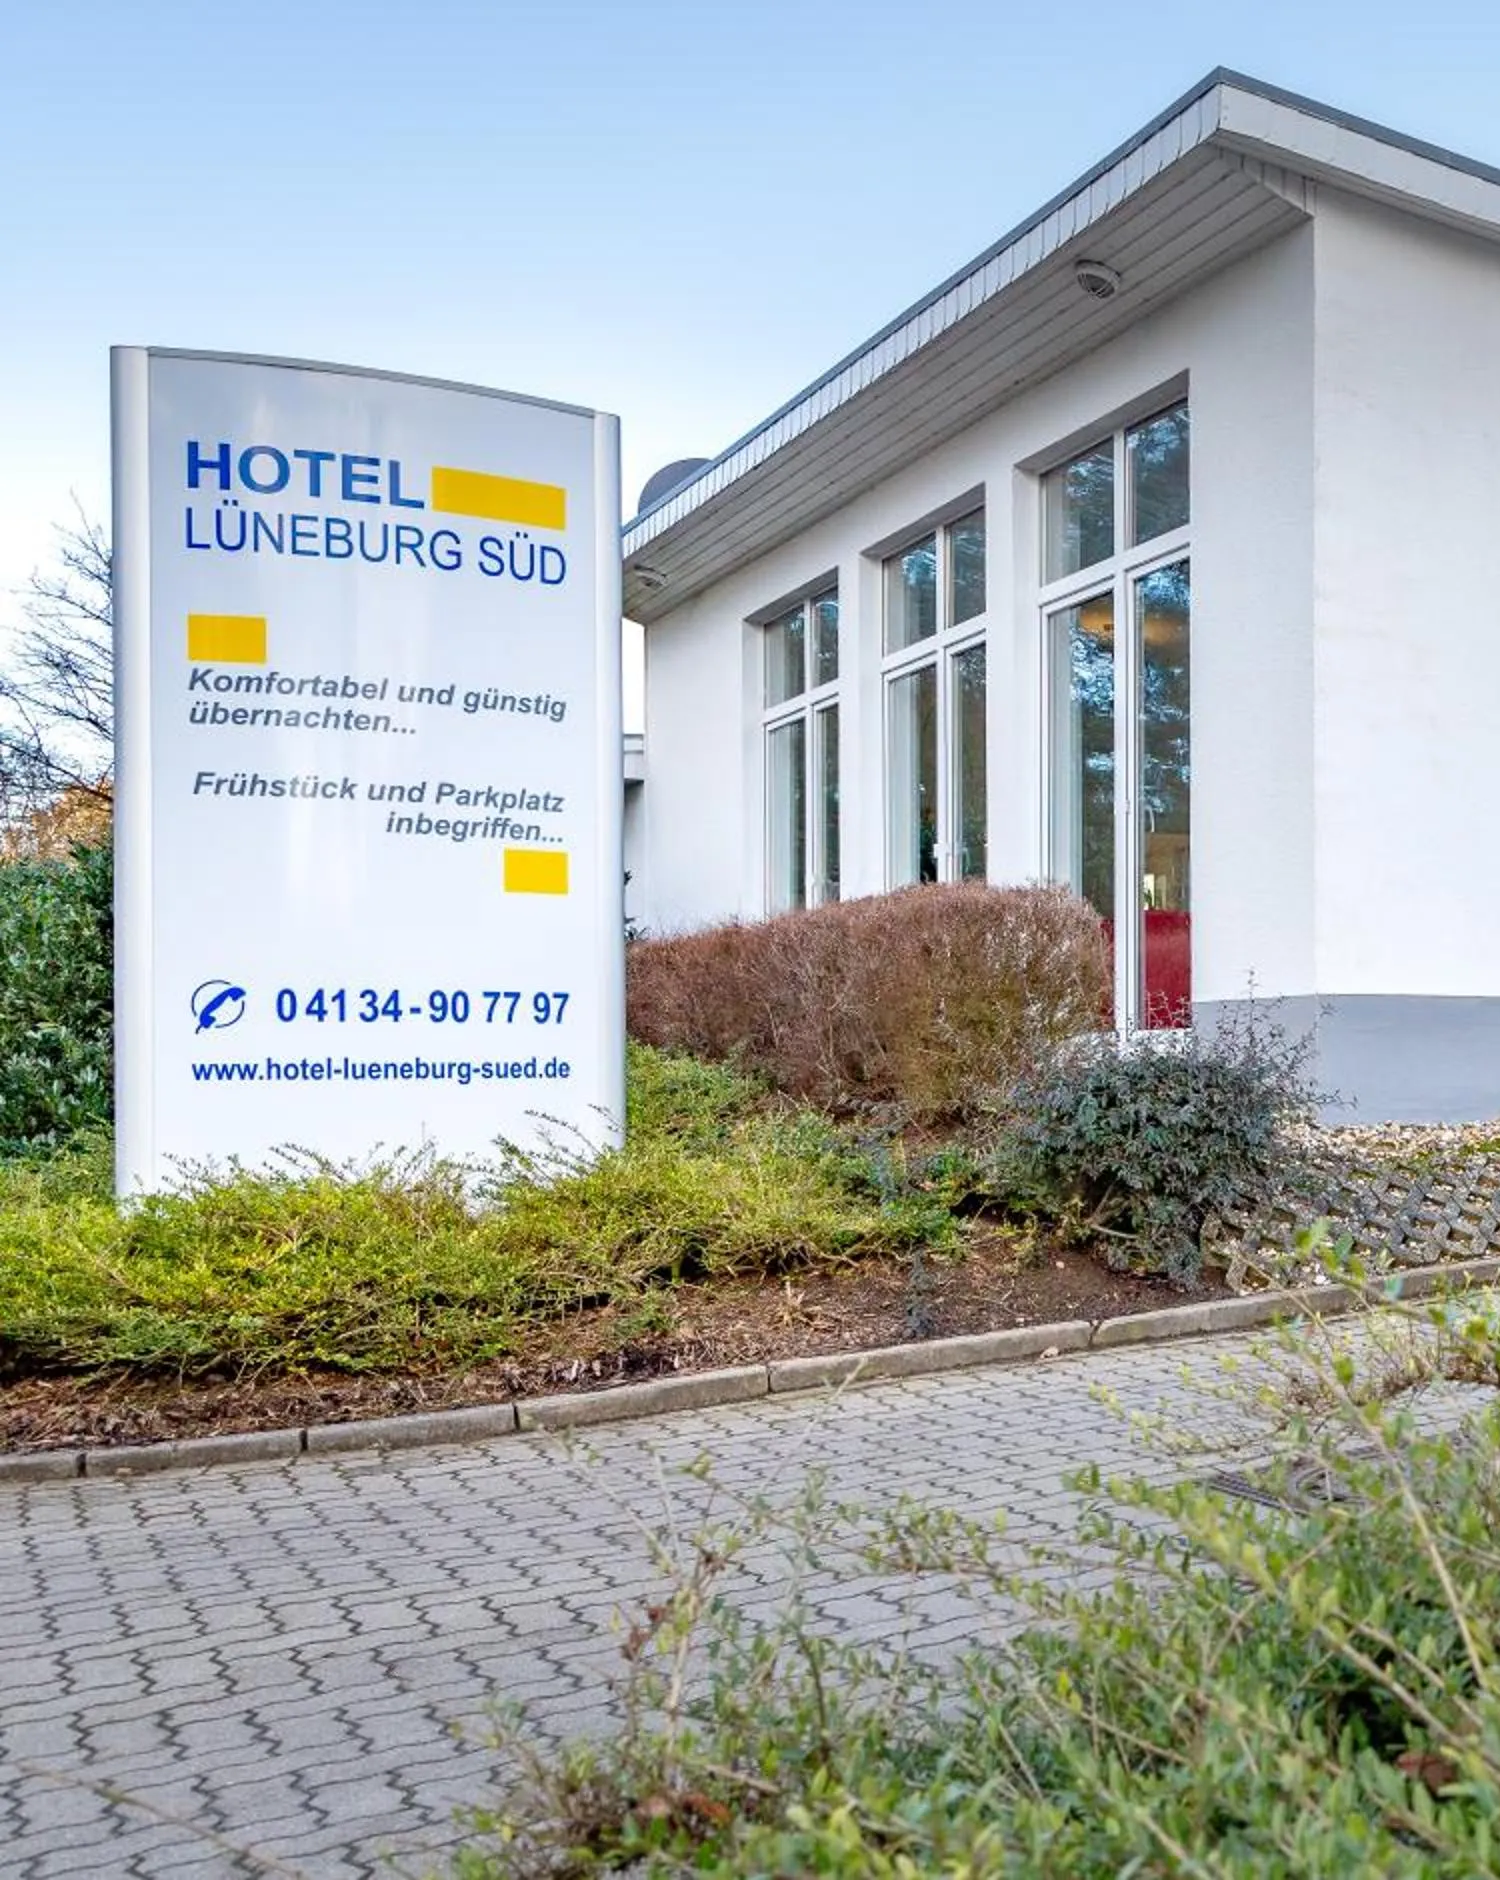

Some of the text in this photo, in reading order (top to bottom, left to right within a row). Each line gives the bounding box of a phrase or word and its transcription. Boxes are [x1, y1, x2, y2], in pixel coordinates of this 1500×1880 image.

[186, 441, 425, 510] HOTEL
[184, 499, 567, 586] LÜNEBURG SÜD
[187, 668, 567, 722] Komfortabel und günstig
[188, 702, 416, 735] übernachten...
[192, 771, 566, 813] Frühstück und Parkplatz
[386, 811, 564, 843] inbegriffen...
[191, 1056, 571, 1085] www.hotel-lueneburg-sued.de
